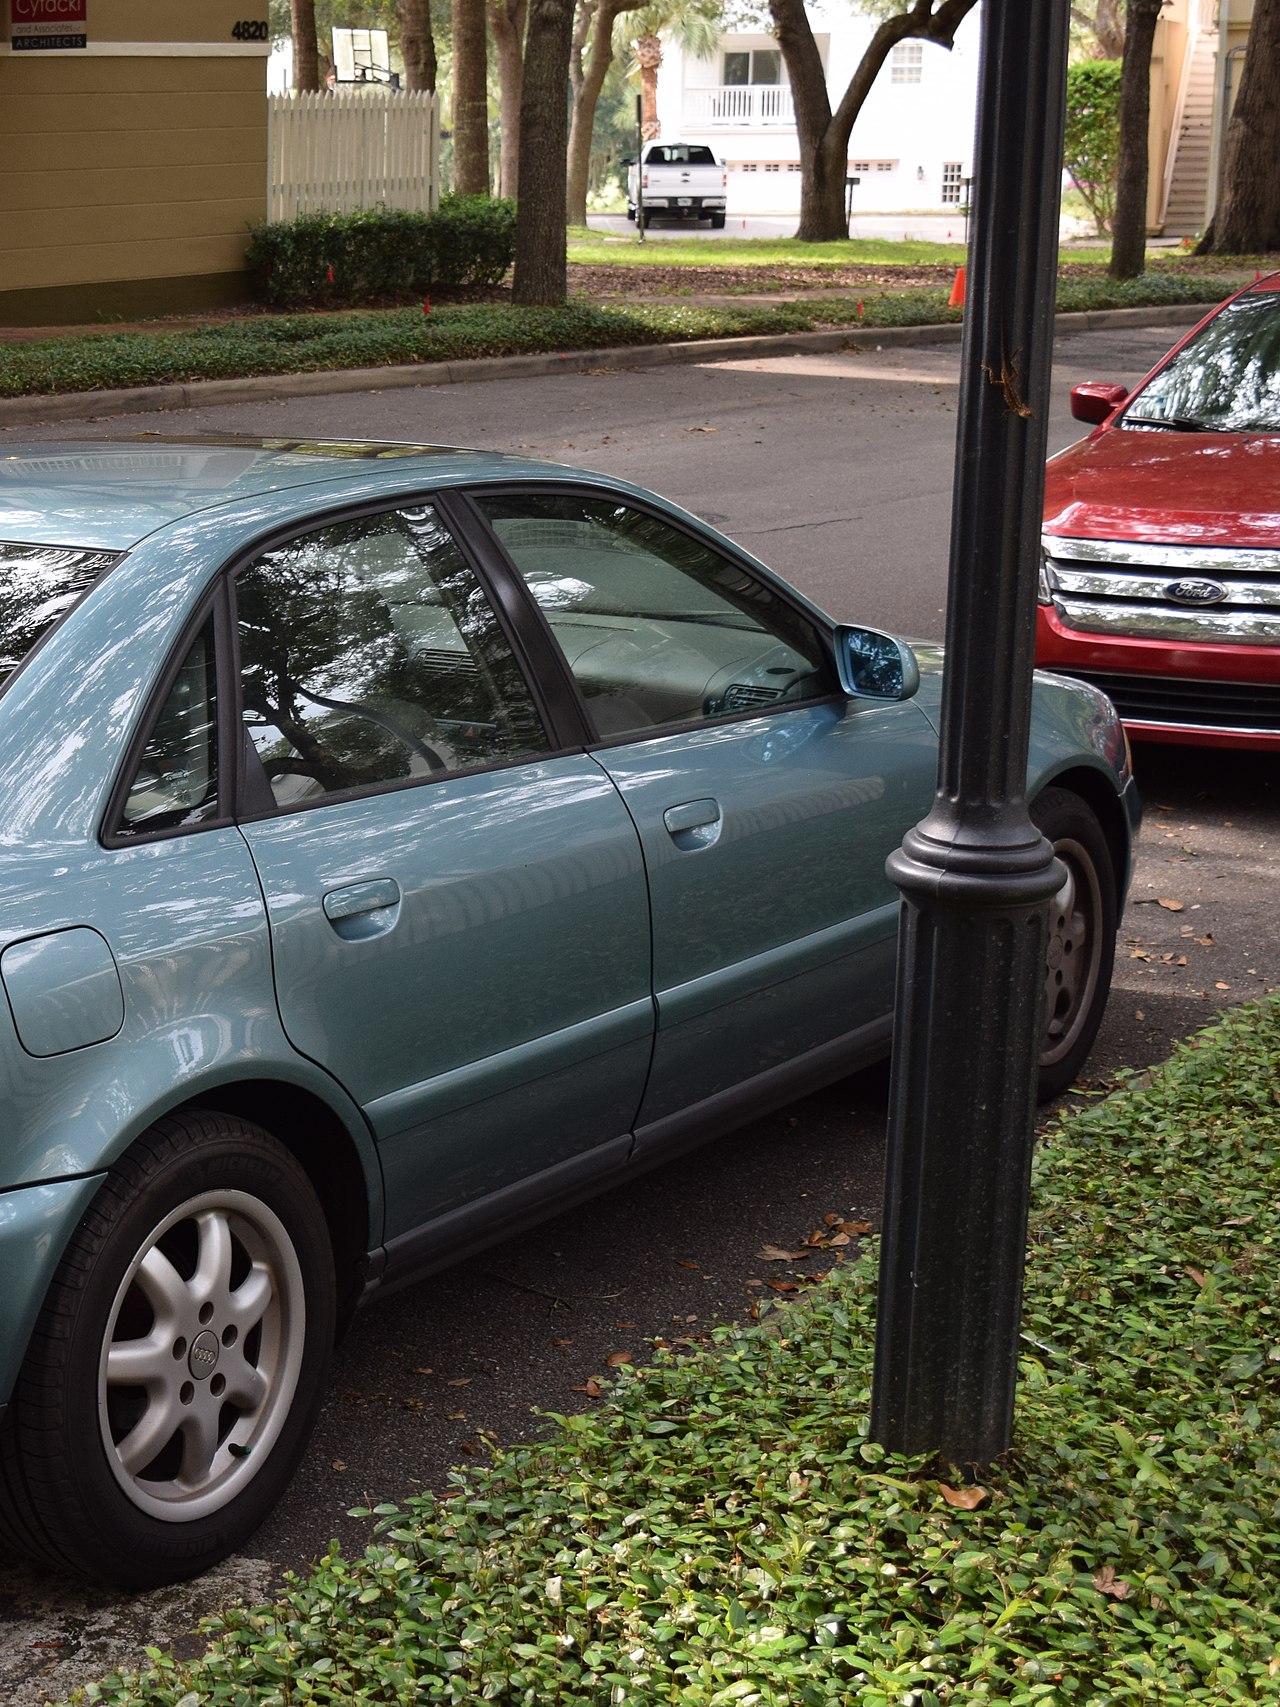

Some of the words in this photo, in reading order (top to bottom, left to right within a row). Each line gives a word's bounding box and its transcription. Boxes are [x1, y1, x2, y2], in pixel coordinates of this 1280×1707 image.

[16, 25, 32, 35] and
[34, 23, 73, 34] Associates
[231, 20, 269, 41] 4820
[15, 37, 83, 49] ARCHITECTS
[1175, 581, 1213, 598] Ford
